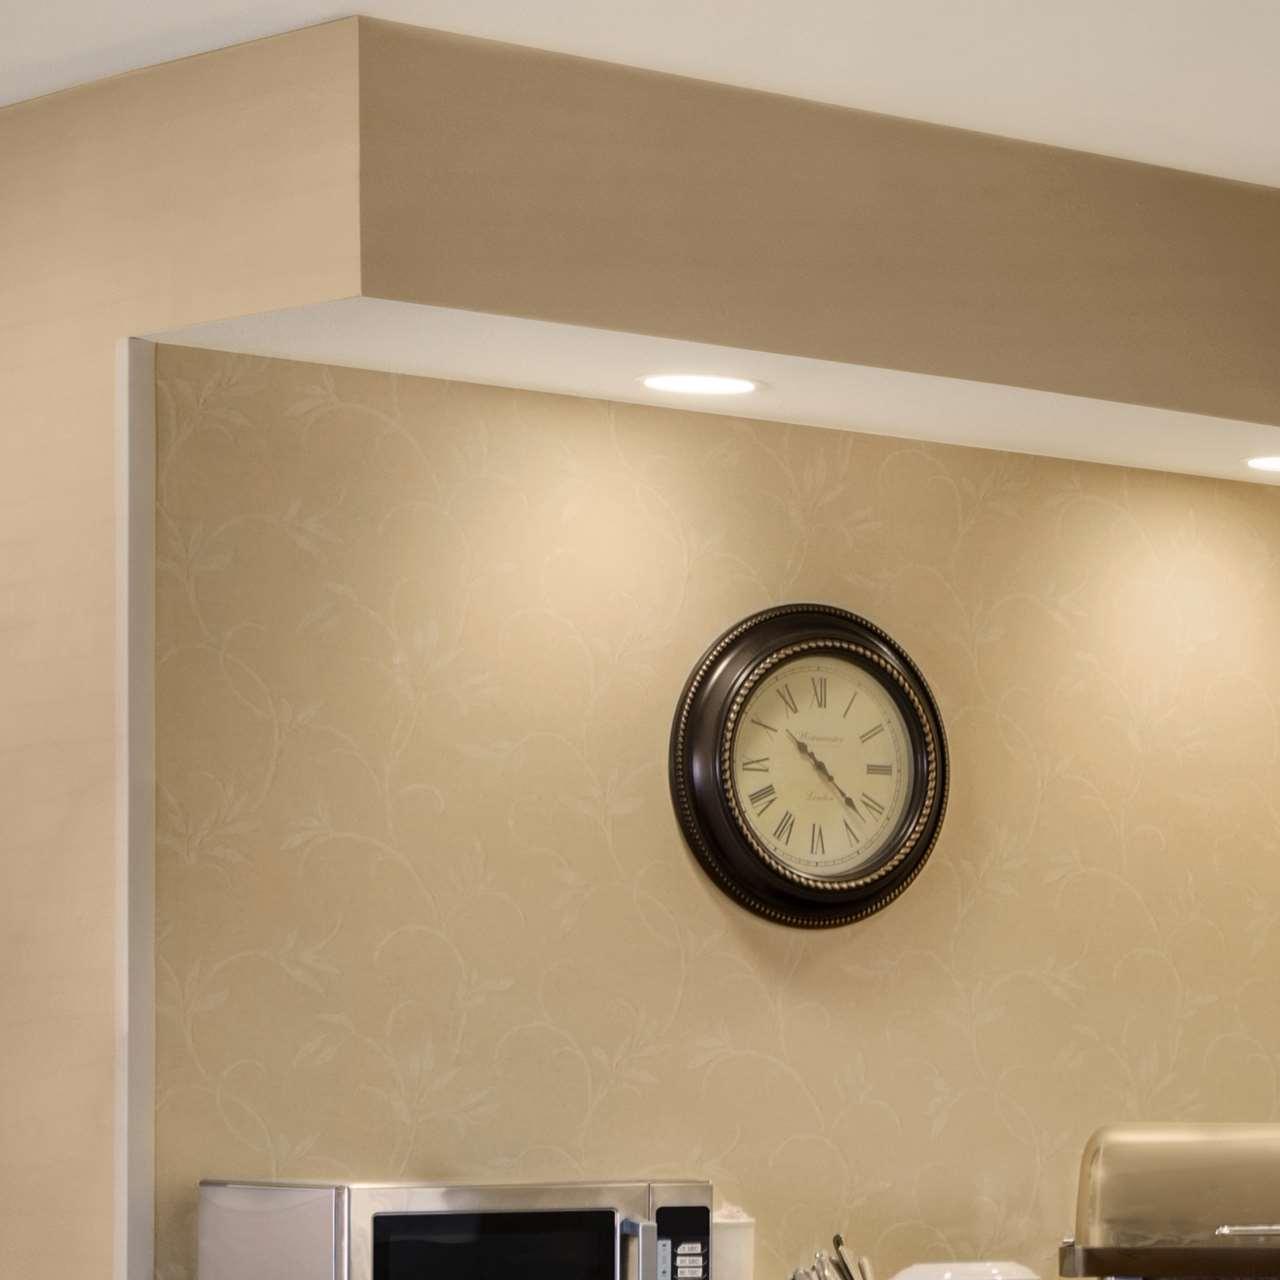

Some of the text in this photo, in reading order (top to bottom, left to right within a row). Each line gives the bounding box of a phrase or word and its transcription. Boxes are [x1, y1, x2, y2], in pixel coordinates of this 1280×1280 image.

[811, 676, 828, 709] XII
[859, 723, 885, 744] II
[866, 763, 893, 776] III
